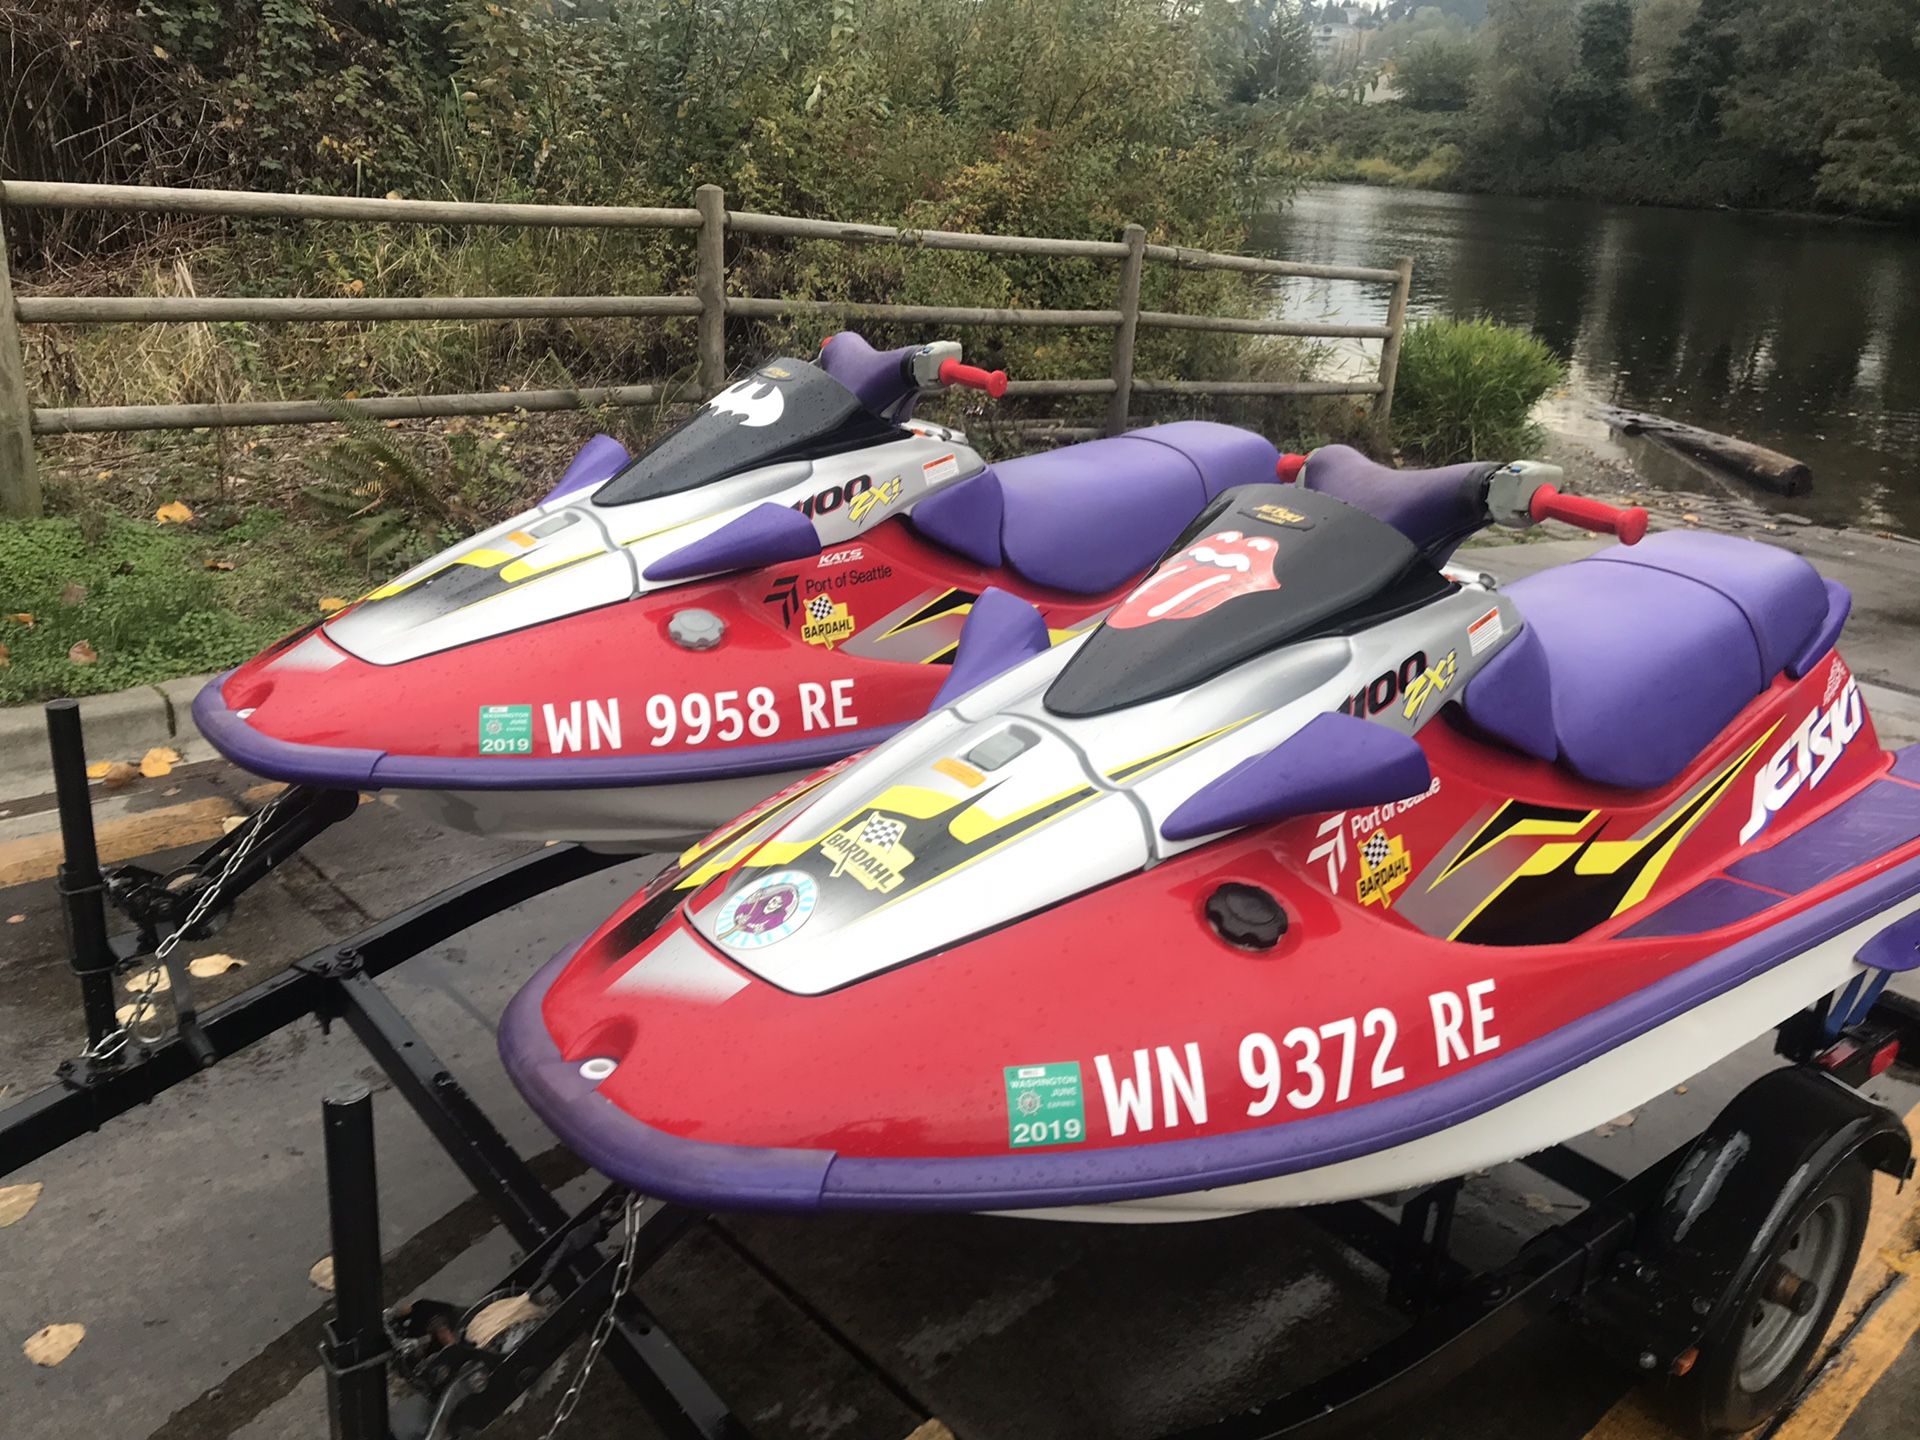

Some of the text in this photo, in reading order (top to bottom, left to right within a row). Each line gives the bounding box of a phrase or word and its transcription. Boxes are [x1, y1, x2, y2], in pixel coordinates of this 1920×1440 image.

[791, 474, 872, 521] 100
[805, 565, 892, 594] Port of Seattle
[803, 618, 853, 639] BARDAHL
[542, 678, 858, 754] WN 9958 RE
[482, 738, 529, 752] 2019
[1350, 805, 1382, 840] Port
[1396, 776, 1441, 814] Seae
[826, 832, 895, 890] BARDAHL
[1358, 857, 1410, 899] BARDAHL
[1094, 978, 1500, 1137] WN 9372 RE
[1012, 1118, 1082, 1144] 2019
